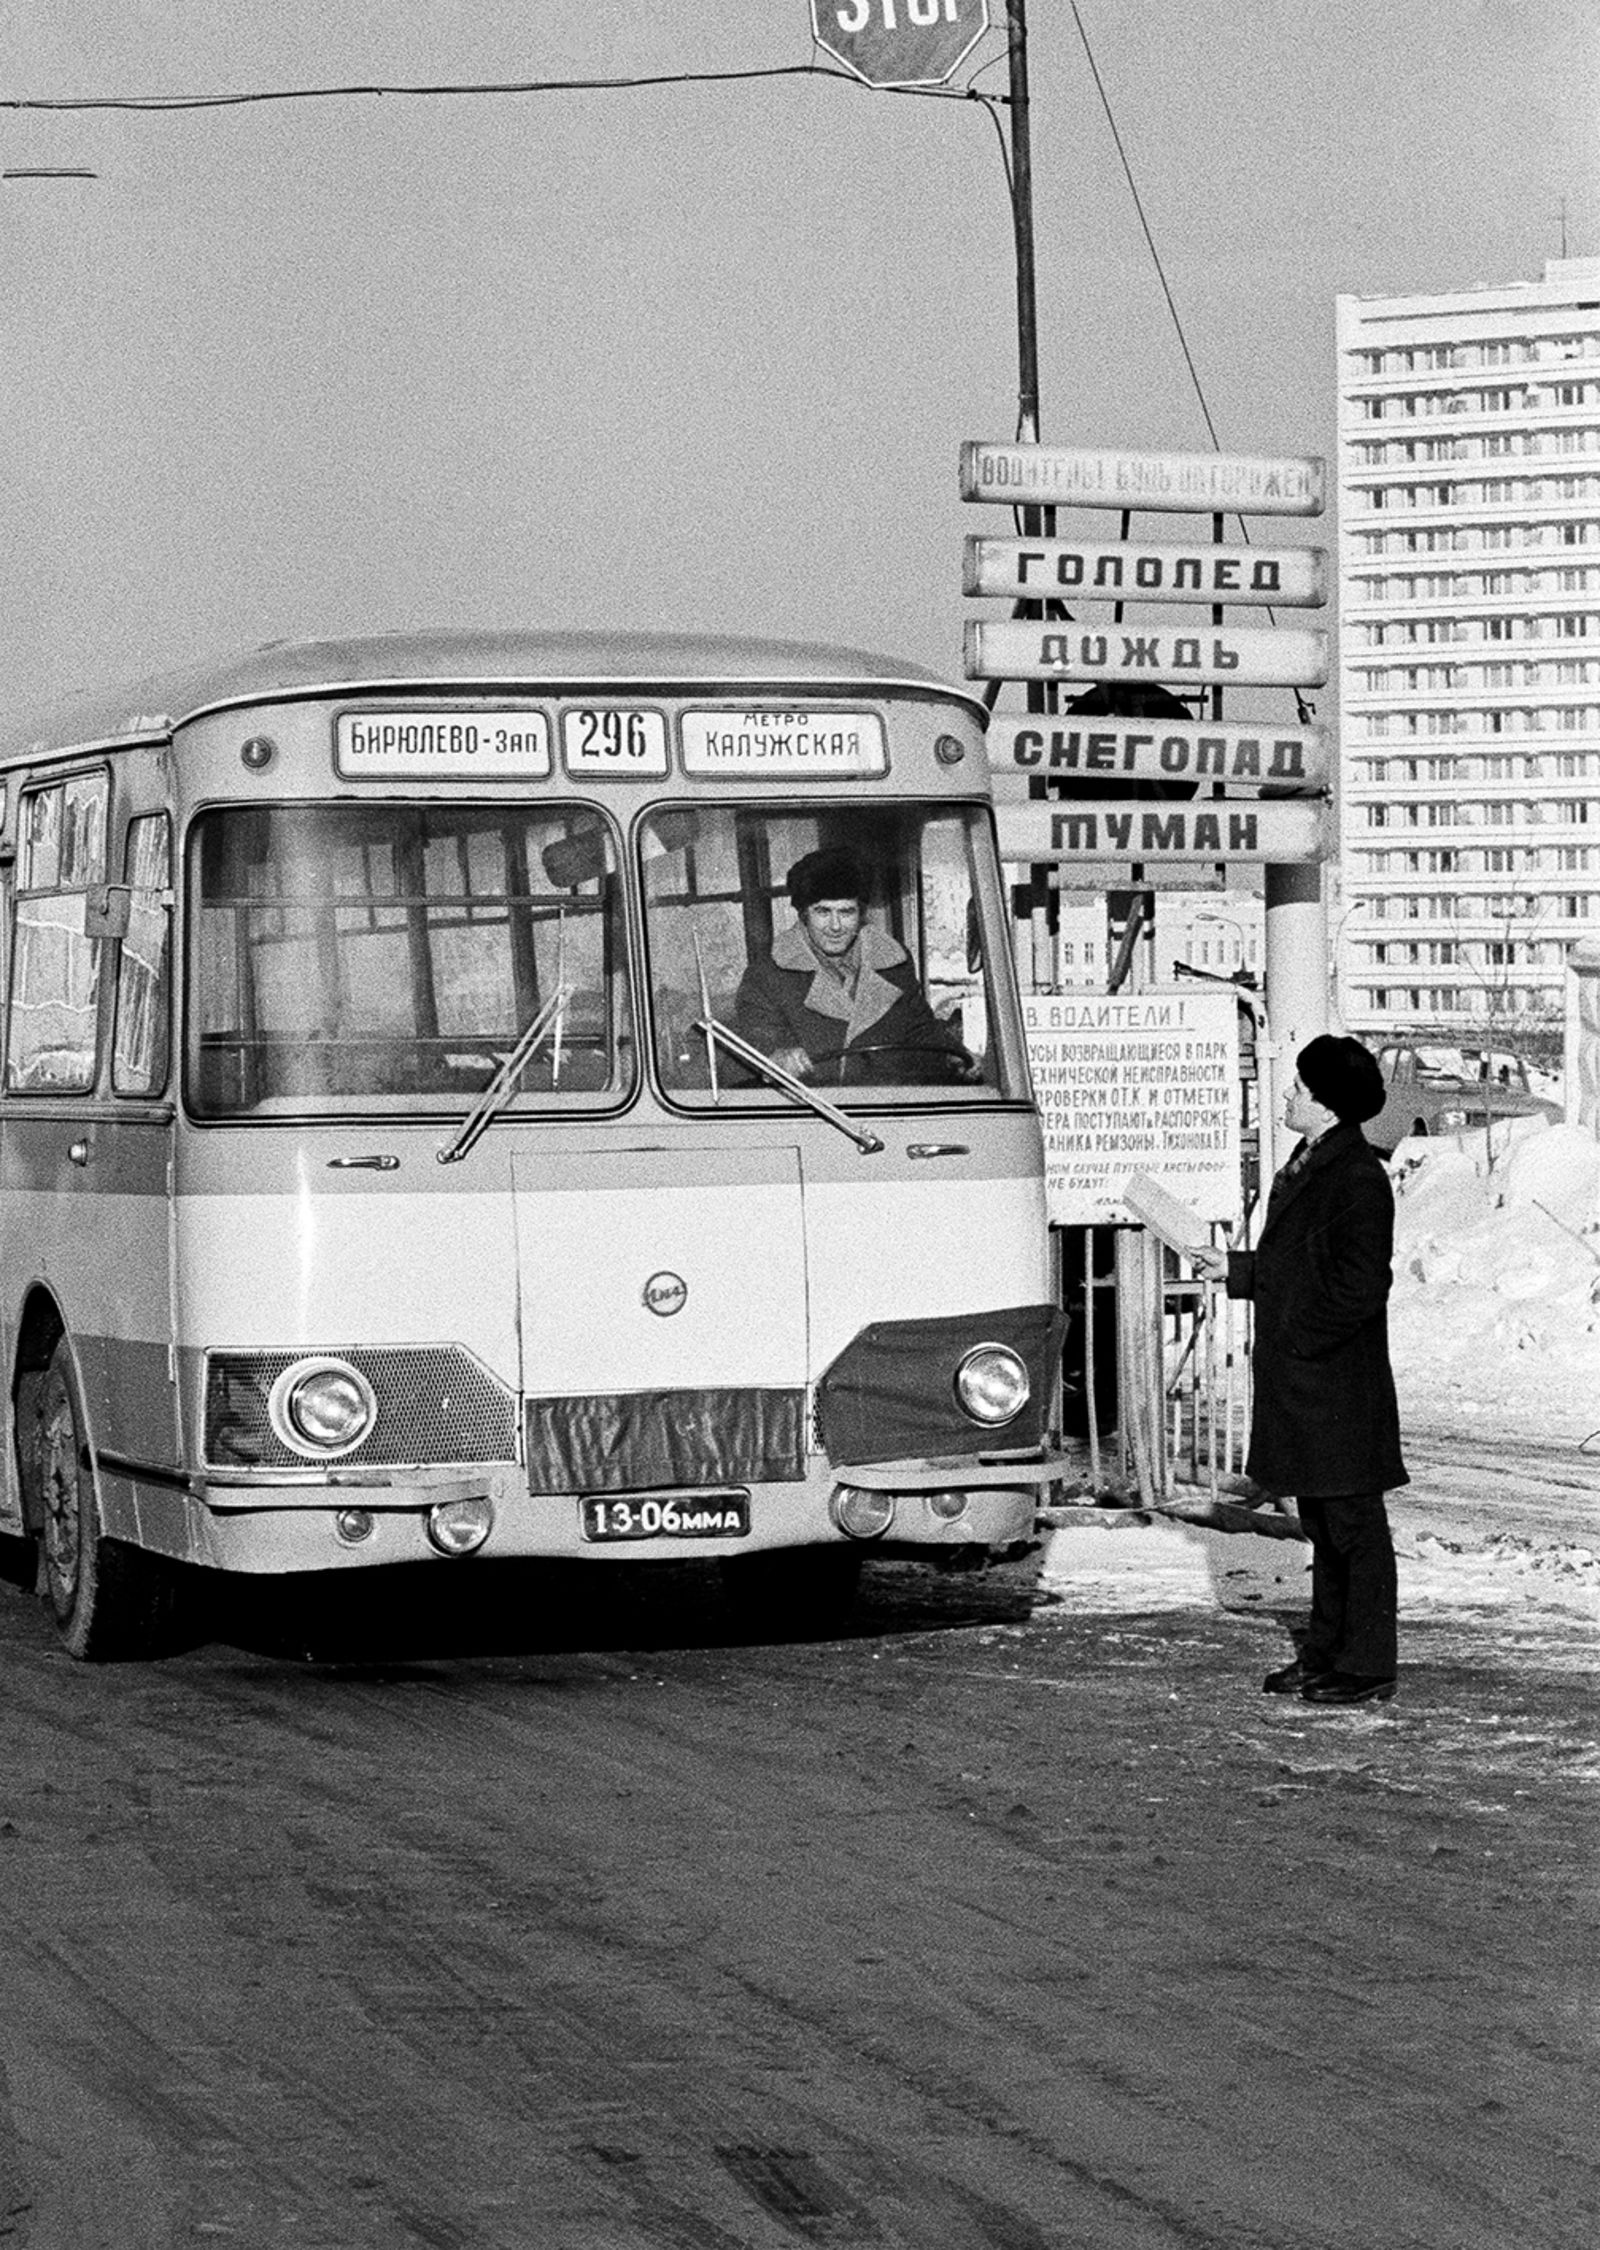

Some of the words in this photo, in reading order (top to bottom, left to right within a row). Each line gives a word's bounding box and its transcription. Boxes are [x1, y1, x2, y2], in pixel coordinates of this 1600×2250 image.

[1017, 552, 1281, 591] ГОЛОЛЕД
[1039, 634, 1240, 670] ДОЖДЬ
[743, 713, 809, 727] МЕТРО
[579, 710, 647, 758] 296
[706, 731, 860, 758] КАЛУЖСКАЯ
[1013, 730, 1306, 778] СНЕГОПАД
[1051, 813, 1258, 850] ТУМАН
[1195, 1042, 1228, 1060] ПАРК
[1123, 1064, 1225, 1084] НЕИСПРАВНОСТИ
[1163, 1087, 1229, 1106] ОТМЕТКИ
[1074, 1111, 1147, 1130] ПОСТУПАЮТ
